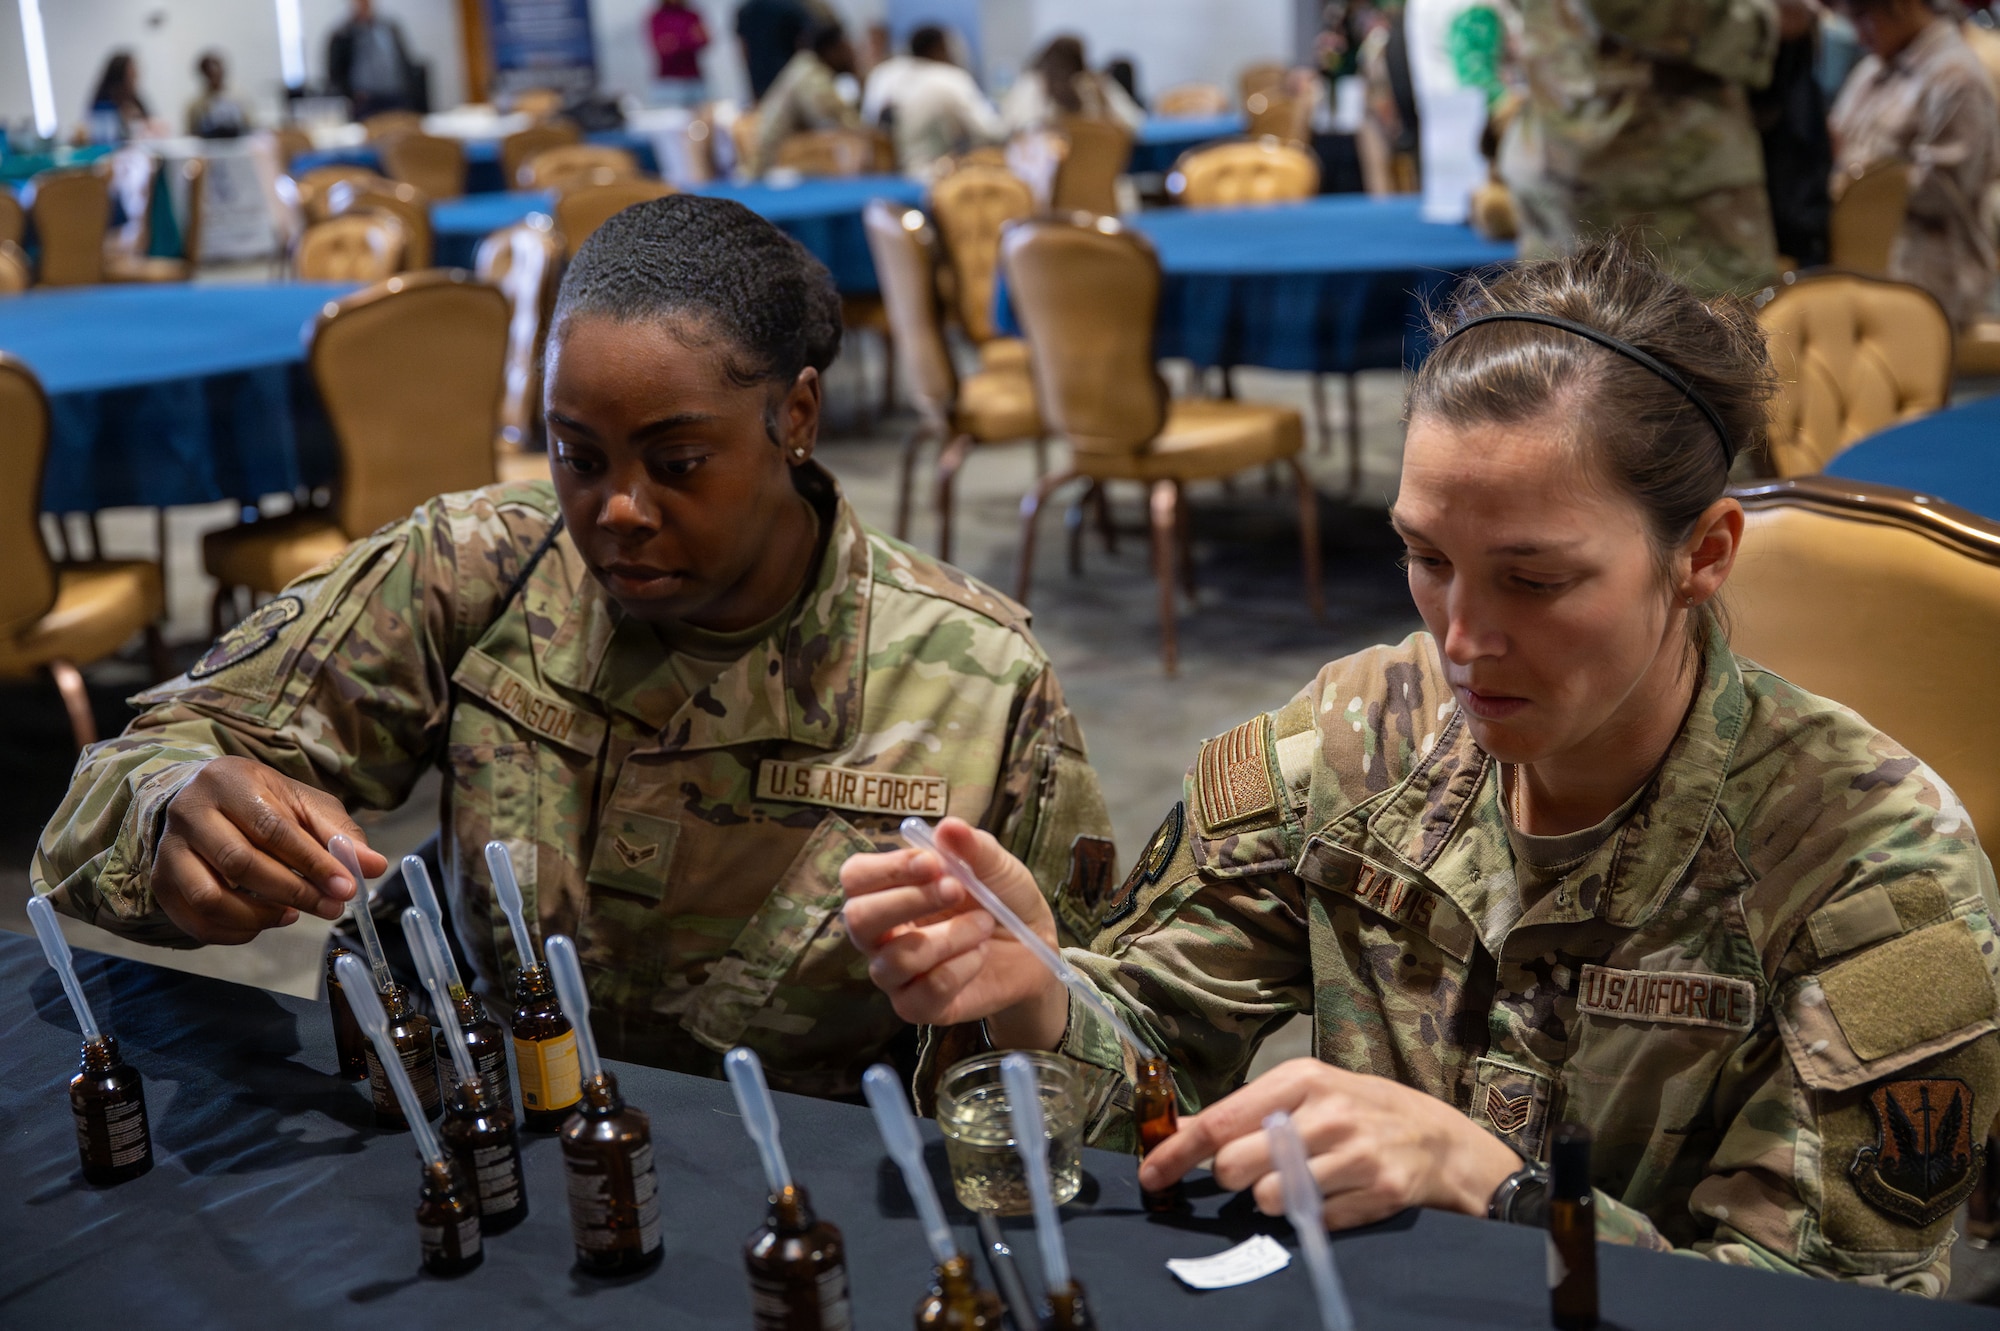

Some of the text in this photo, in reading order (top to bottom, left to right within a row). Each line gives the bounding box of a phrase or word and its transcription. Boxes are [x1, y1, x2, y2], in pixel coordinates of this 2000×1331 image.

[770, 765, 940, 812] U.S. AIR FORCE
[1351, 863, 1437, 929] DAVIS
[1654, 977, 1744, 1024] FORCE
